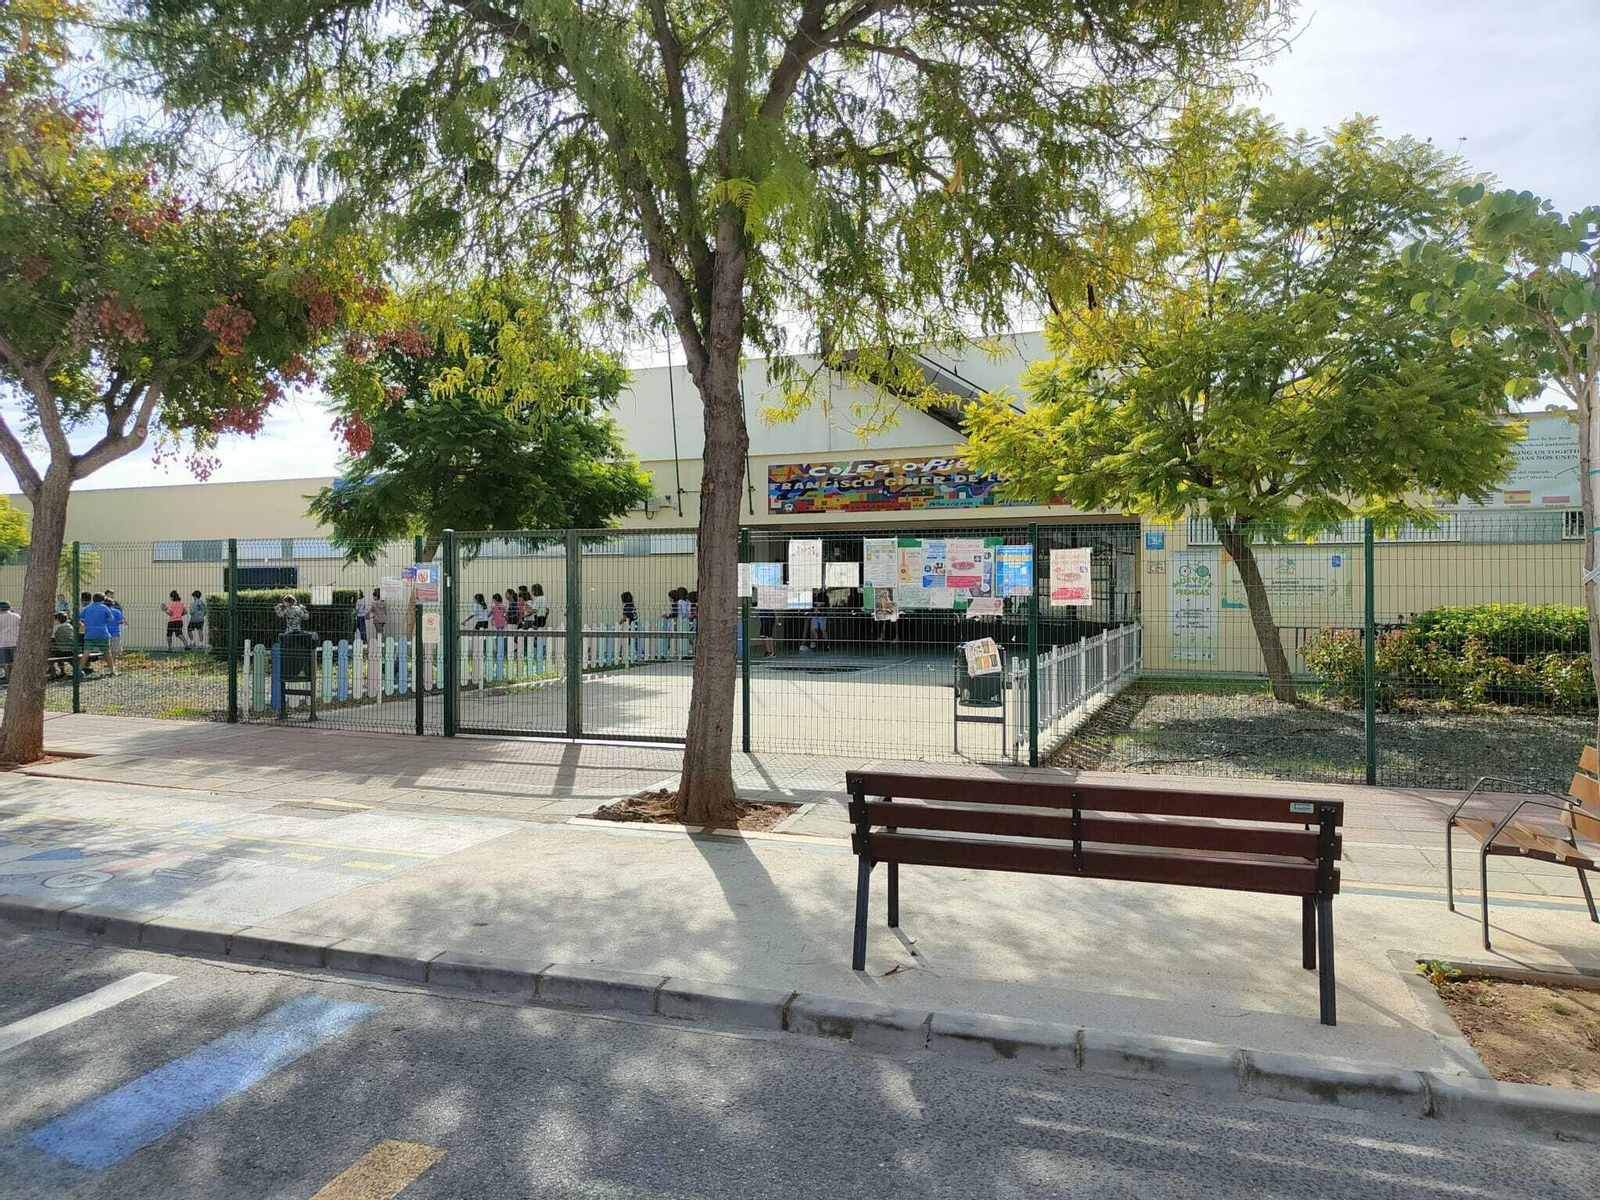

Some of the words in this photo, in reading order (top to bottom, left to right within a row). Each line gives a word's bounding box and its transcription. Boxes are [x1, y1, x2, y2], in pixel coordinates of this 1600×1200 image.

[808, 460, 918, 477] COLEGIO
[884, 475, 946, 487] GINER
[954, 473, 979, 484] DE
